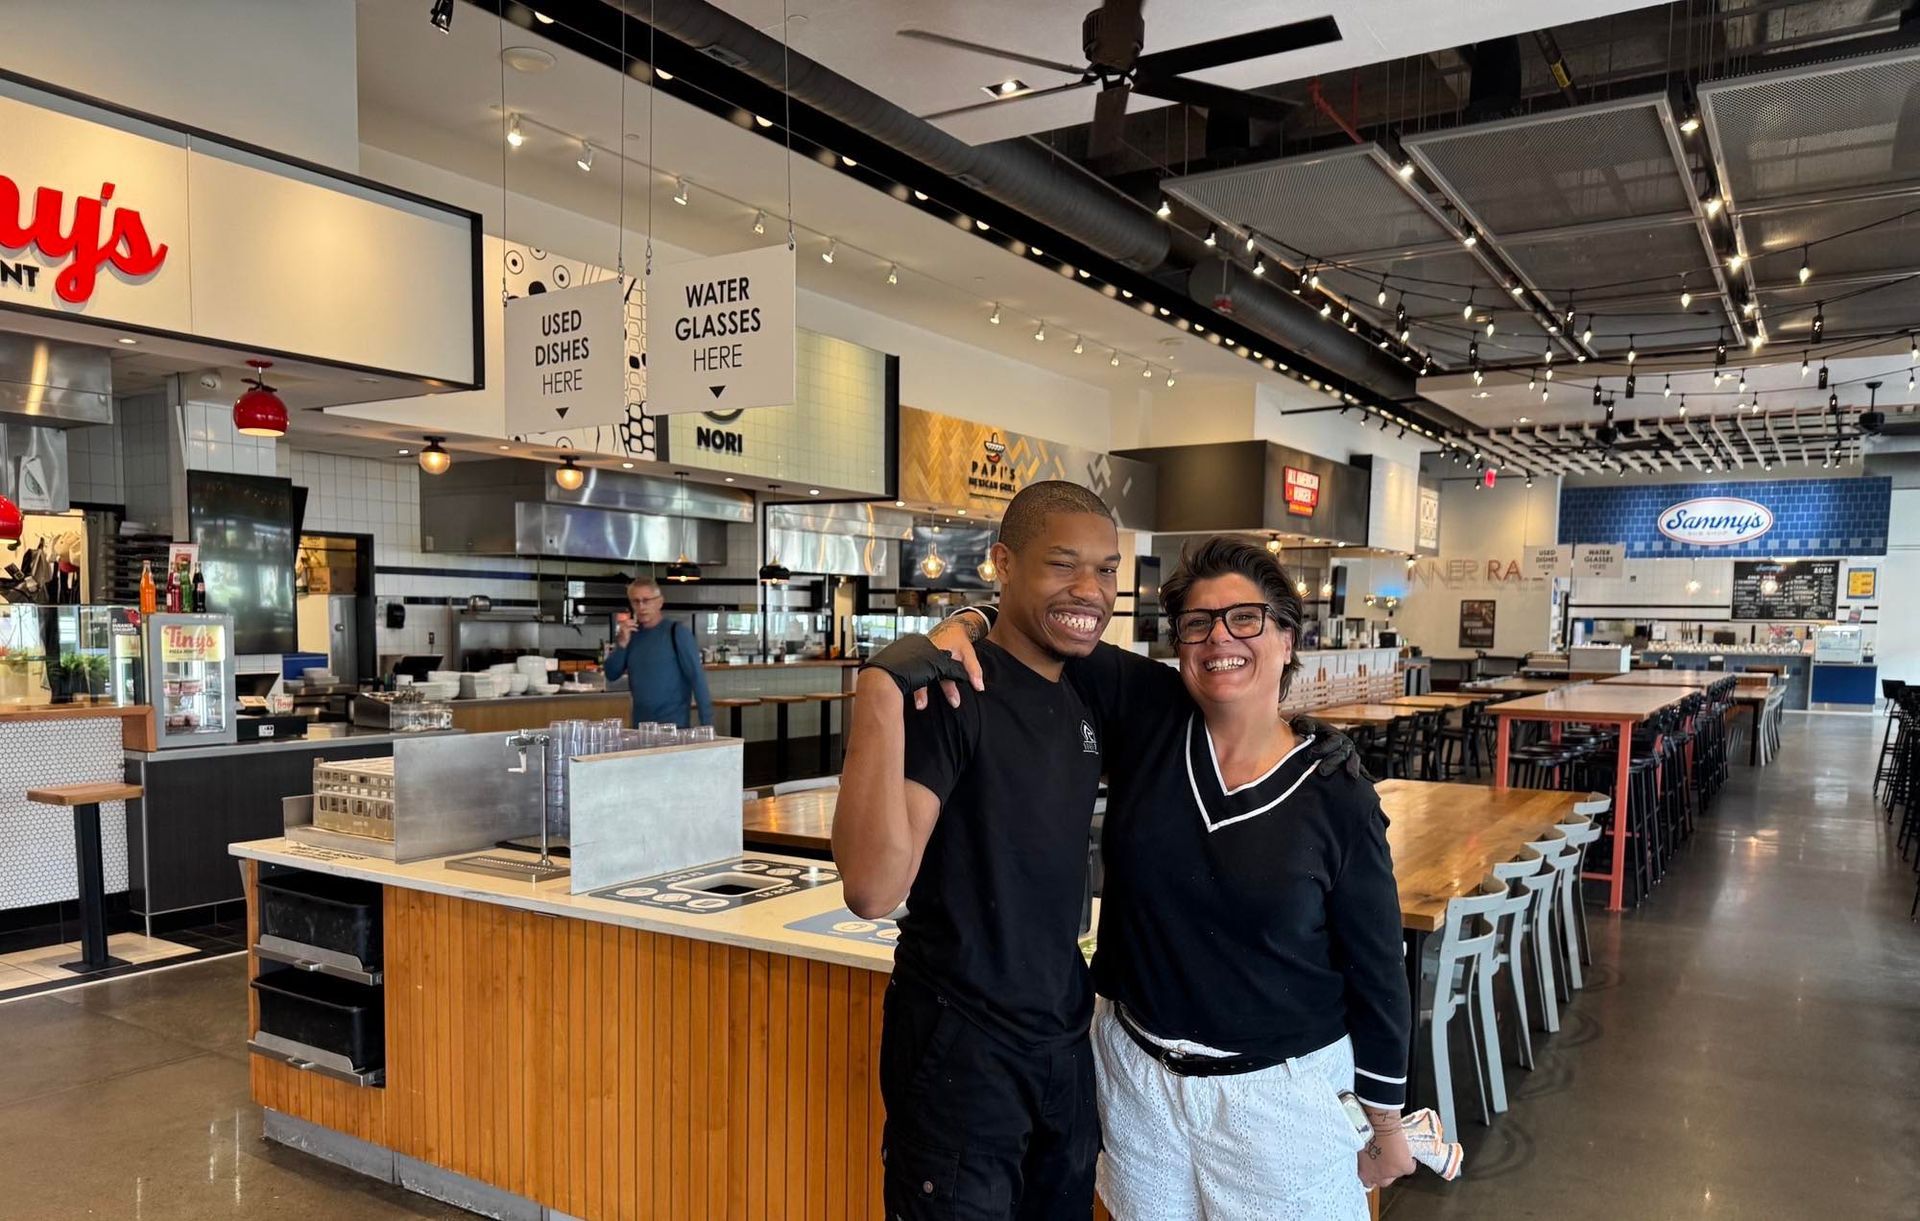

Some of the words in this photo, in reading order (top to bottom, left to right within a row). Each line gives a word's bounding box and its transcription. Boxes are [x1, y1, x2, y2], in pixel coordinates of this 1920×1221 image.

[685, 276, 750, 308] WATER
[541, 309, 582, 336] USED
[675, 307, 762, 341] GLASSES
[535, 337, 590, 367] DISHES
[693, 344, 743, 372] HERE
[542, 369, 583, 395] HERE
[697, 426, 743, 454] NORI
[971, 461, 1015, 481] PAPI'S
[1666, 508, 1764, 534] Sammy's
[163, 624, 217, 655] Tiny's
[755, 885, 801, 898] trash
